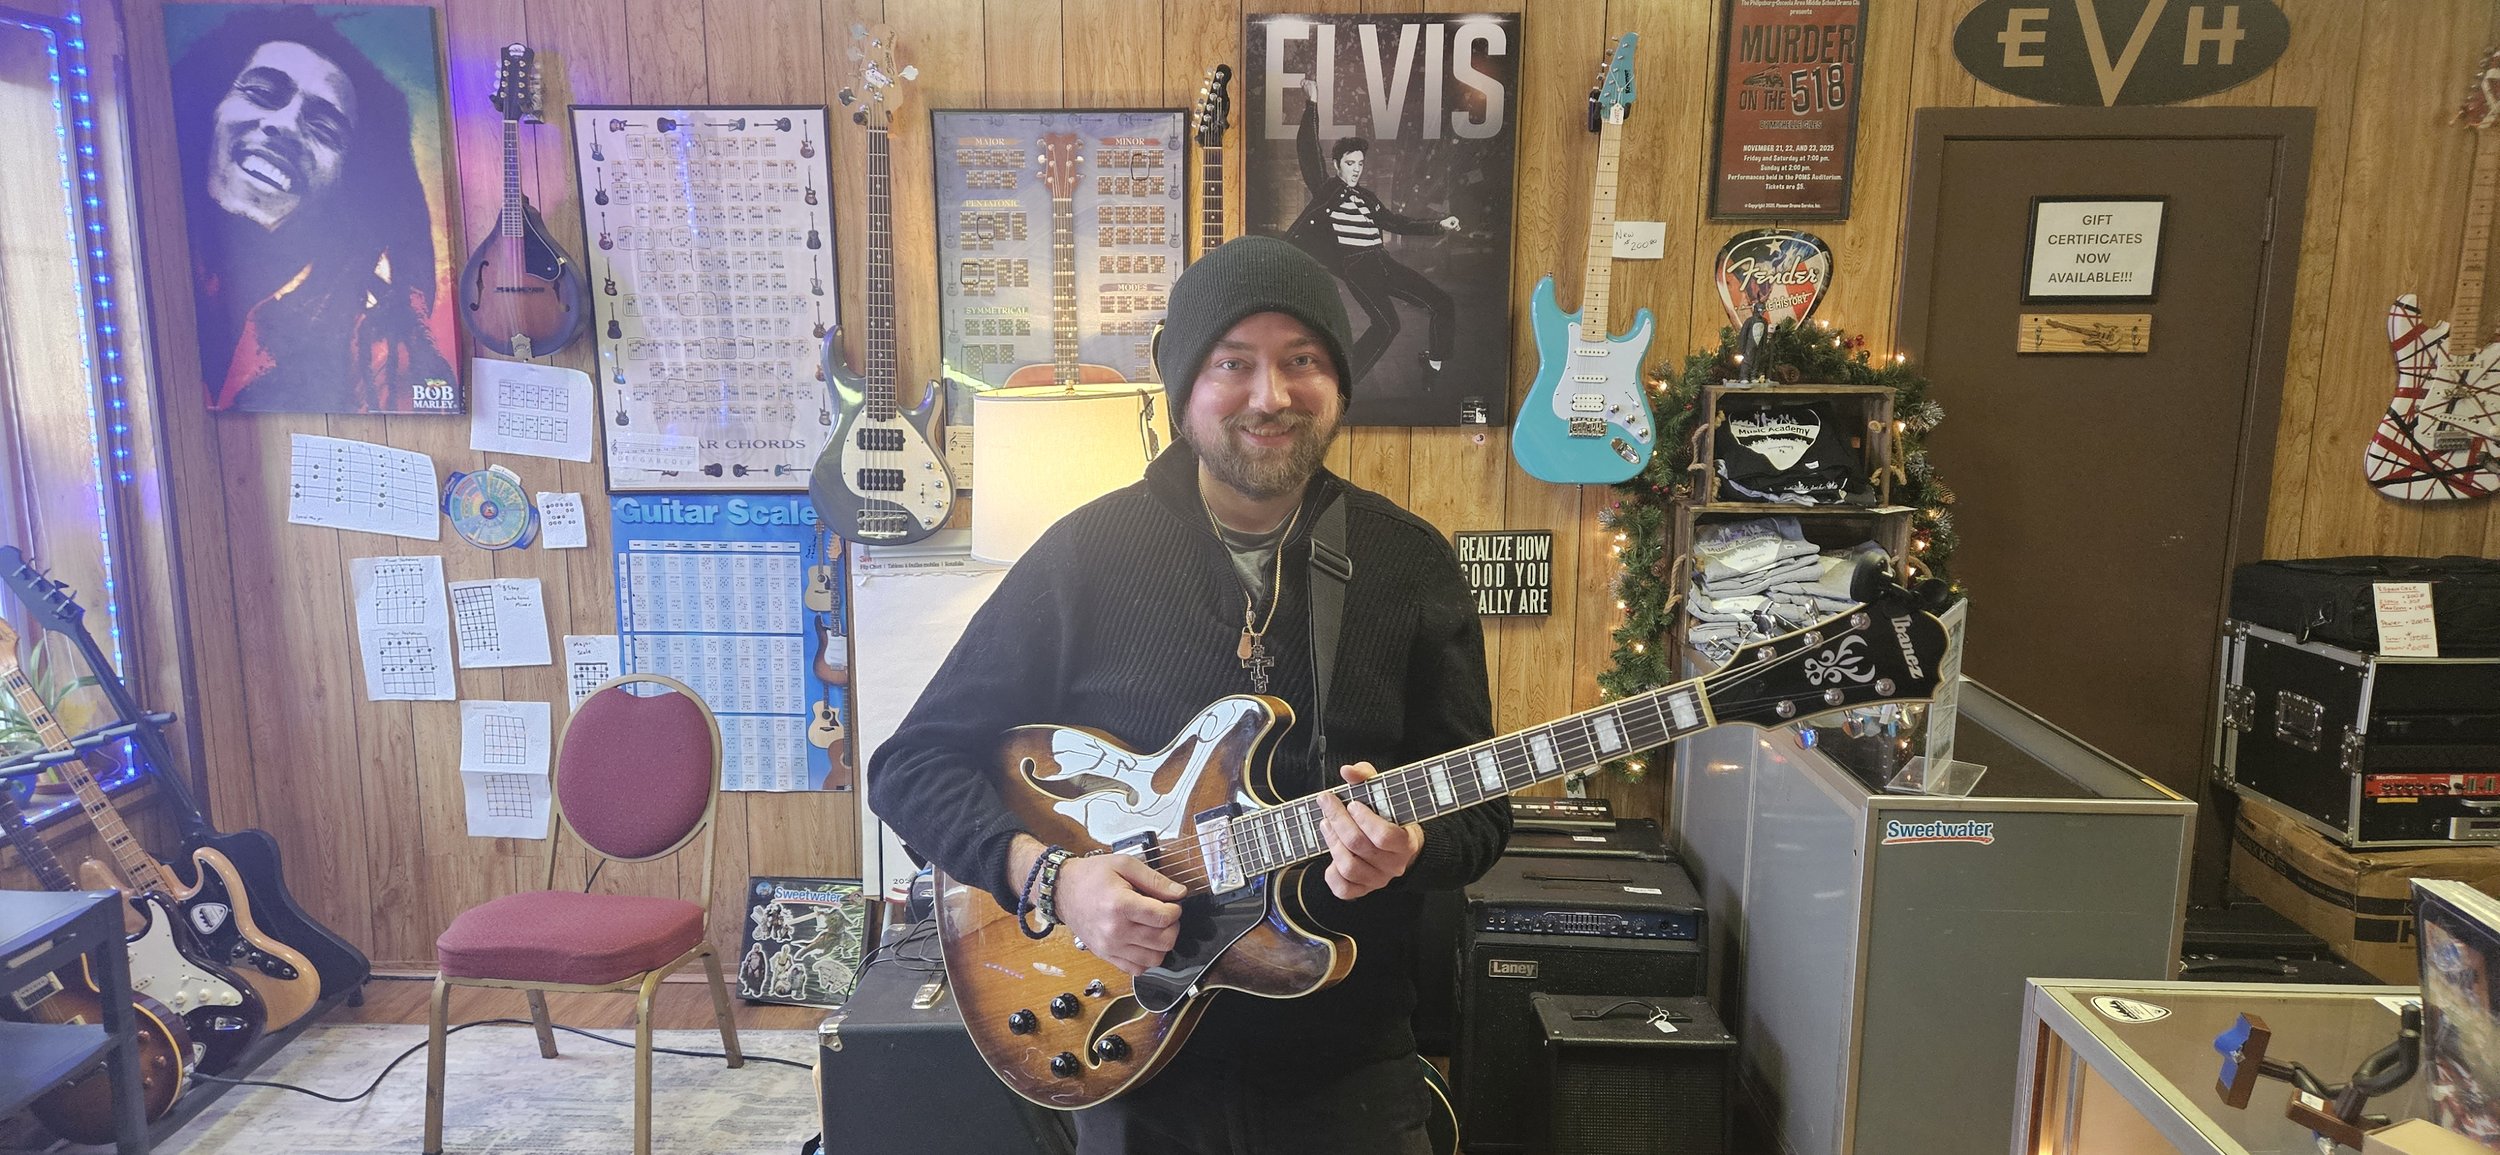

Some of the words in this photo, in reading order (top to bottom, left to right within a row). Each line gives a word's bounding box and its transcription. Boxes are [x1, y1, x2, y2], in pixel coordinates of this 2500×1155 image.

[1740, 24, 1858, 64] MURDER
[1997, 0, 2245, 107] EVH
[1265, 23, 1507, 140] ELVIS
[1740, 90, 1758, 111] ON
[1764, 90, 1786, 111] THE
[1790, 62, 1846, 115] 518
[1744, 155, 1761, 163] Friday
[1773, 155, 1799, 163] Saturday
[1760, 164, 1780, 172] Sunday
[2082, 214, 2113, 225] GIFT
[1615, 228, 1634, 240] New
[2048, 233, 2143, 245] CERTIFICATES
[2075, 253, 2111, 264] NOW
[1727, 256, 1817, 291] Fender
[2048, 272, 2133, 283] AVAILABLE!!!
[1118, 283, 1147, 291] MODES
[1777, 294, 1808, 308] HISTORY
[412, 385, 454, 400] BOB
[413, 400, 454, 409] MARLEY
[1768, 425, 1810, 436] Academy
[730, 439, 806, 449] CHORDS
[617, 497, 719, 524] Guitar
[1460, 536, 1513, 561] REALIZE
[1516, 536, 1550, 561] HOW
[1708, 543, 1733, 553] Music
[1515, 562, 1548, 587] YOU
[1471, 589, 1513, 614] ALLY
[1519, 589, 1548, 614] ARE
[1891, 614, 1924, 680] Ibanez
[1888, 821, 1992, 837] Sweetwater
[774, 887, 841, 903] Sweetwater
[1493, 961, 1536, 976] Laney
